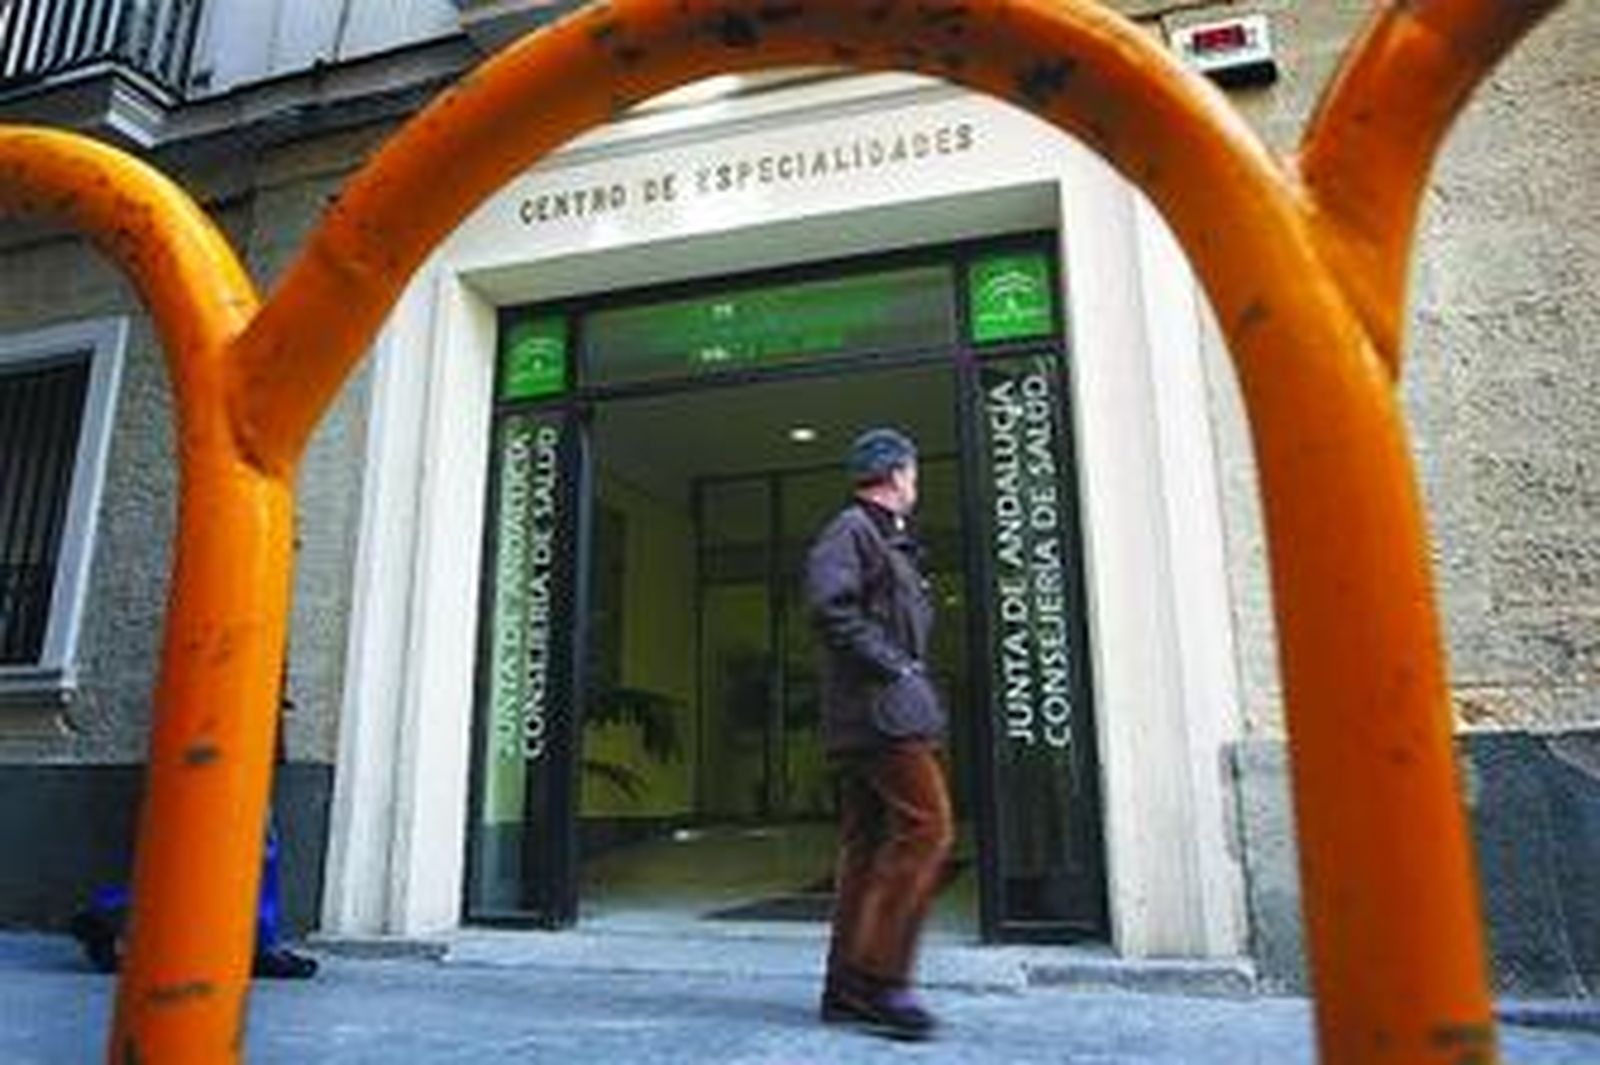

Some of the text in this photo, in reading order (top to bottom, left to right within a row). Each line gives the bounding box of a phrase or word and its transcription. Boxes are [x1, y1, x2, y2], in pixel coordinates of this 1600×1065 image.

[519, 184, 626, 225] CENTRO
[643, 172, 678, 203] DE
[1022, 375, 1056, 476] SALUD
[1030, 484, 1058, 530] DE
[1000, 577, 1029, 622] DE
[1002, 631, 1034, 745] JUNTA
